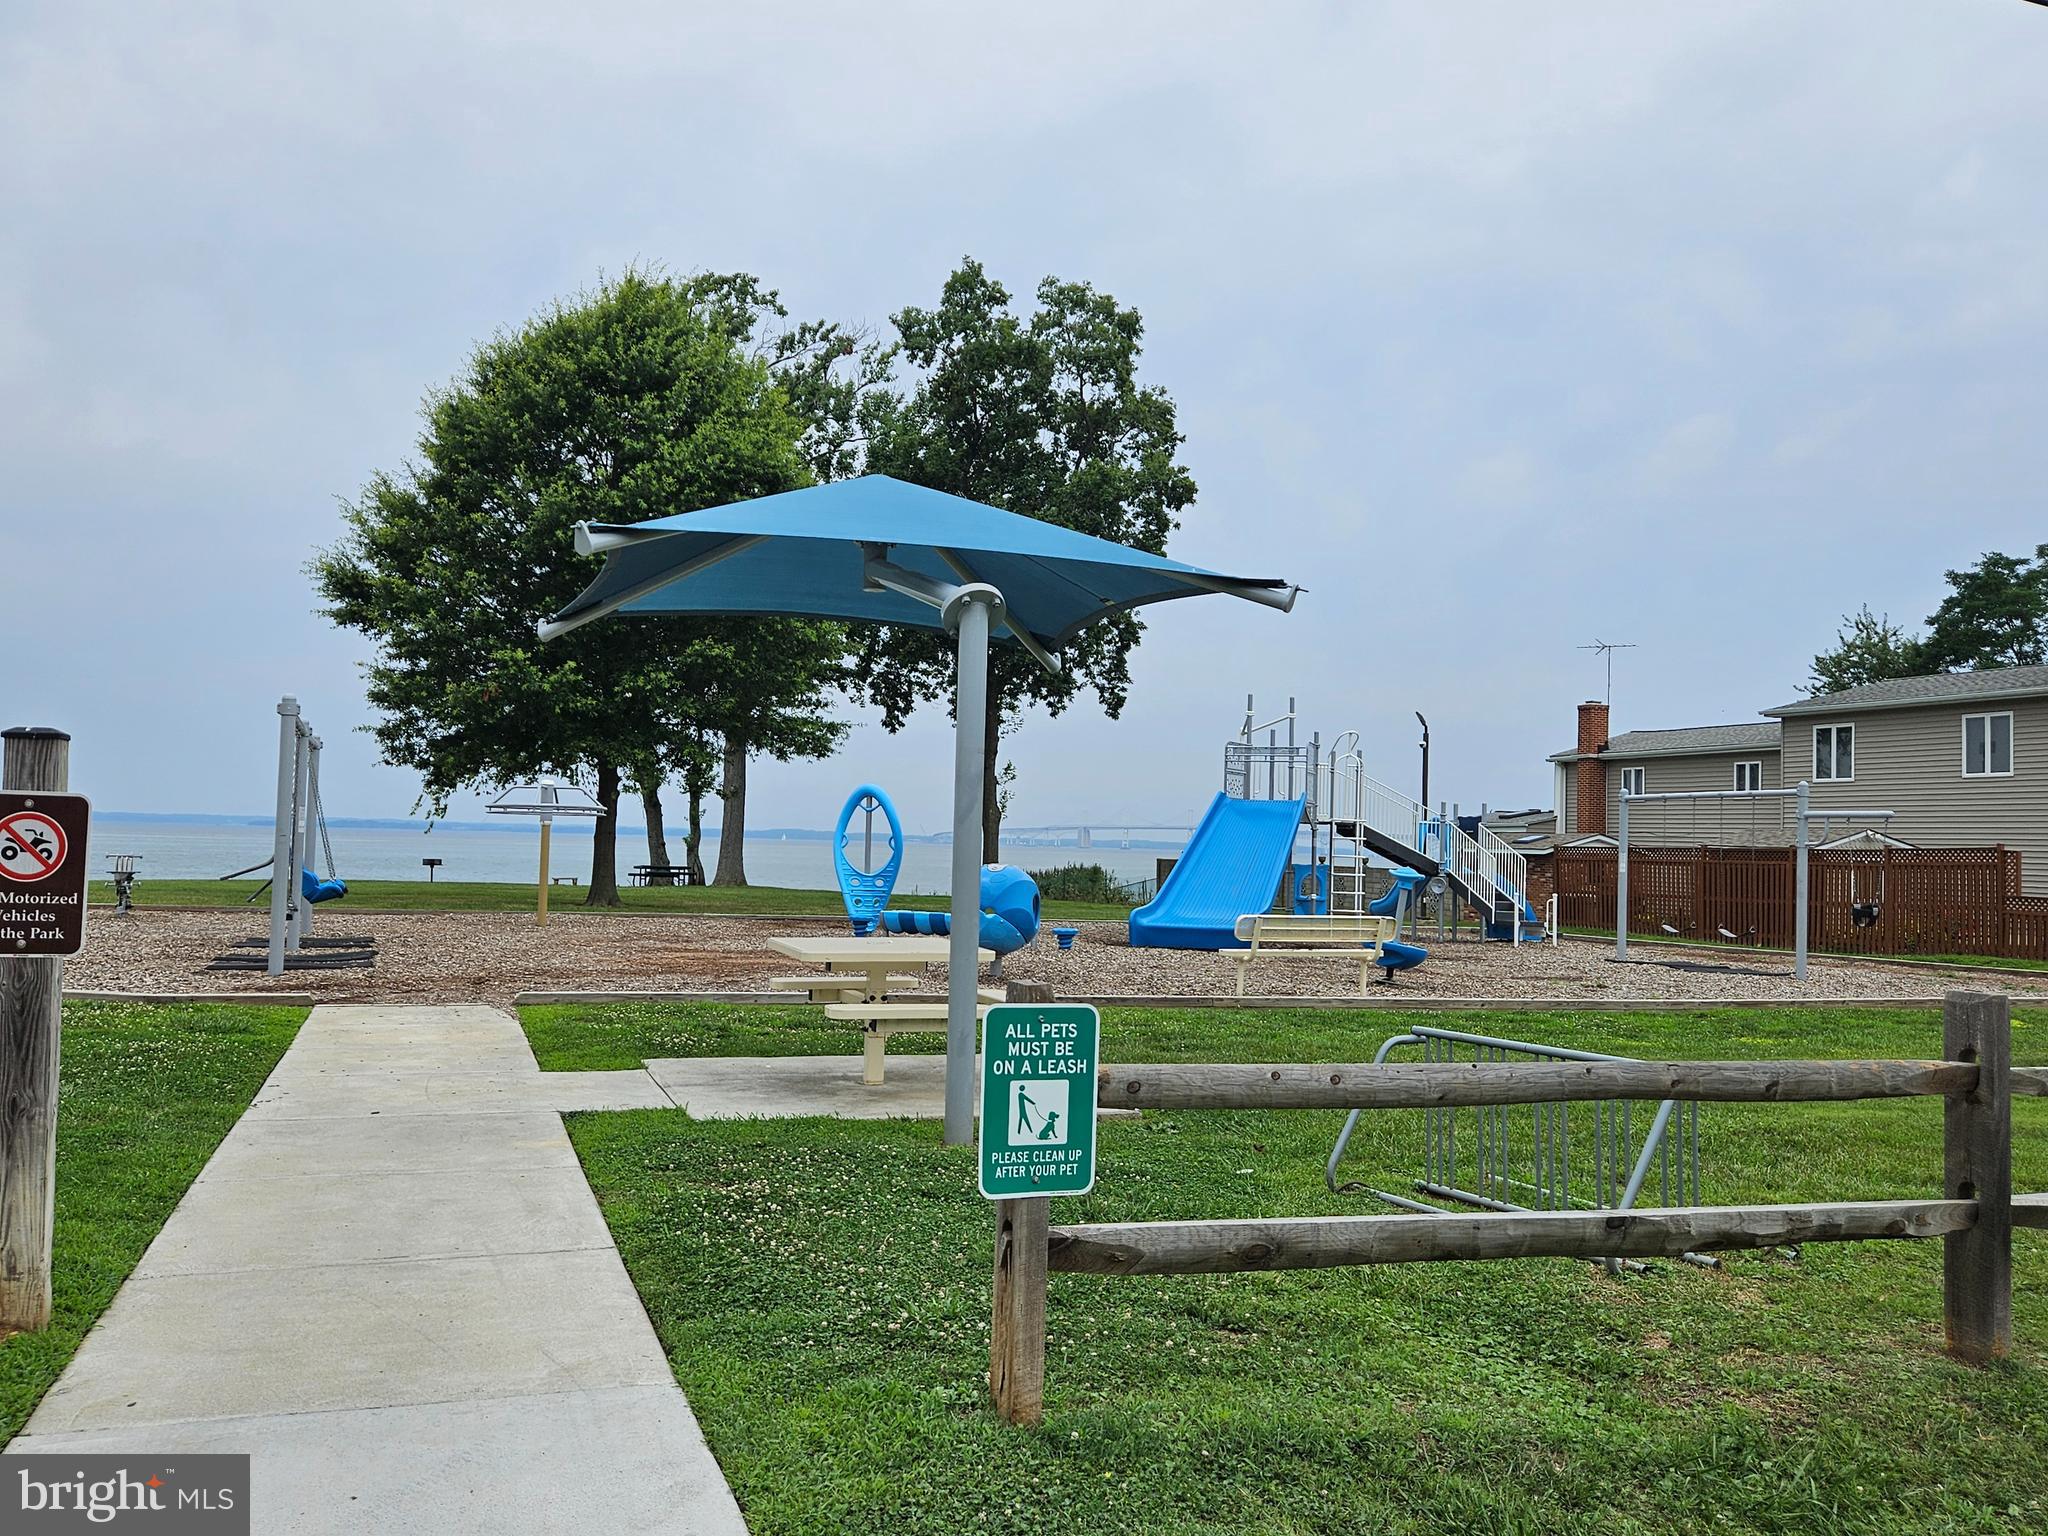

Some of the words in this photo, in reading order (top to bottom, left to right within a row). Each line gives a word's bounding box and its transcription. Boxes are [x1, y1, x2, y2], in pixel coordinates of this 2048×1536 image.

[0, 892, 78, 904] Motorized
[0, 909, 56, 921] ehicles
[0, 927, 25, 939] the
[30, 927, 65, 939] Park
[1005, 1023, 1035, 1038] ALL
[1041, 1023, 1077, 1038] PETS
[1008, 1041, 1049, 1056] MUST
[1055, 1041, 1074, 1056] BE
[993, 1060, 1014, 1075] ON
[1020, 1060, 1032, 1075] A
[1038, 1059, 1087, 1074] LEASH
[991, 1151, 1030, 1164] PLEASE
[1033, 1150, 1065, 1162] CLEAN
[1068, 1149, 1082, 1161] UP
[995, 1165, 1026, 1179] AFTER
[1029, 1164, 1056, 1176] YOUR
[1060, 1163, 1078, 1175] PET
